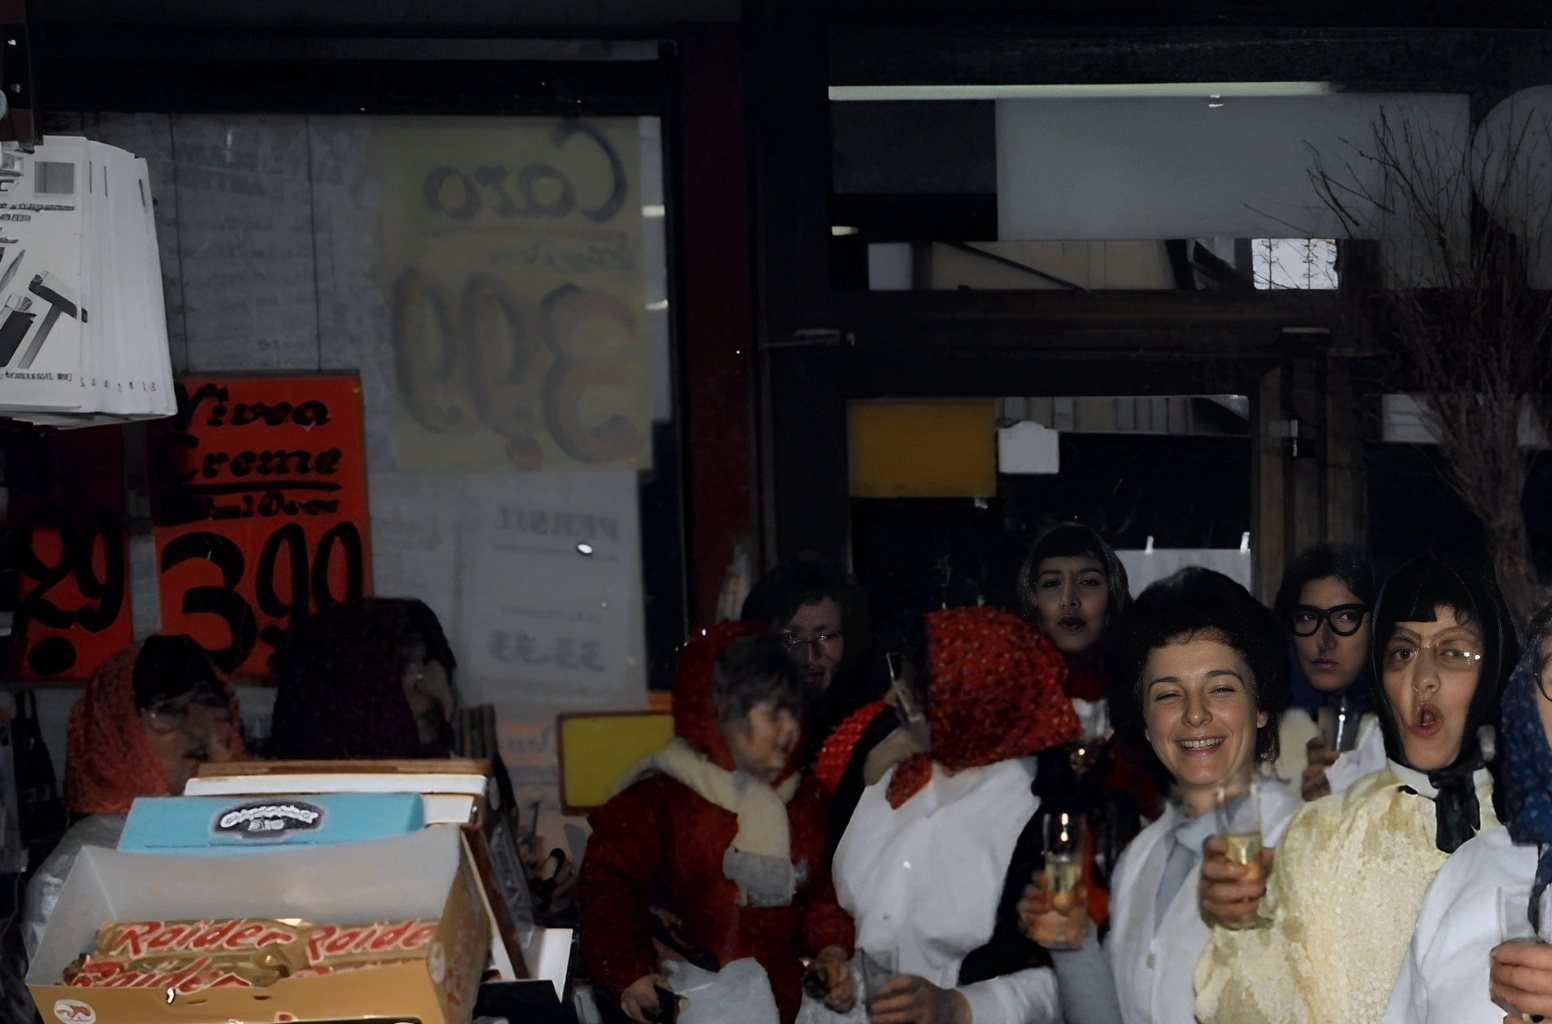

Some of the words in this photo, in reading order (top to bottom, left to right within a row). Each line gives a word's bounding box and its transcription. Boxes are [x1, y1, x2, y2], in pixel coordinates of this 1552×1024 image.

[156, 432, 342, 479] Creme
[108, 918, 297, 960] Raider
[306, 920, 440, 966] Raide
